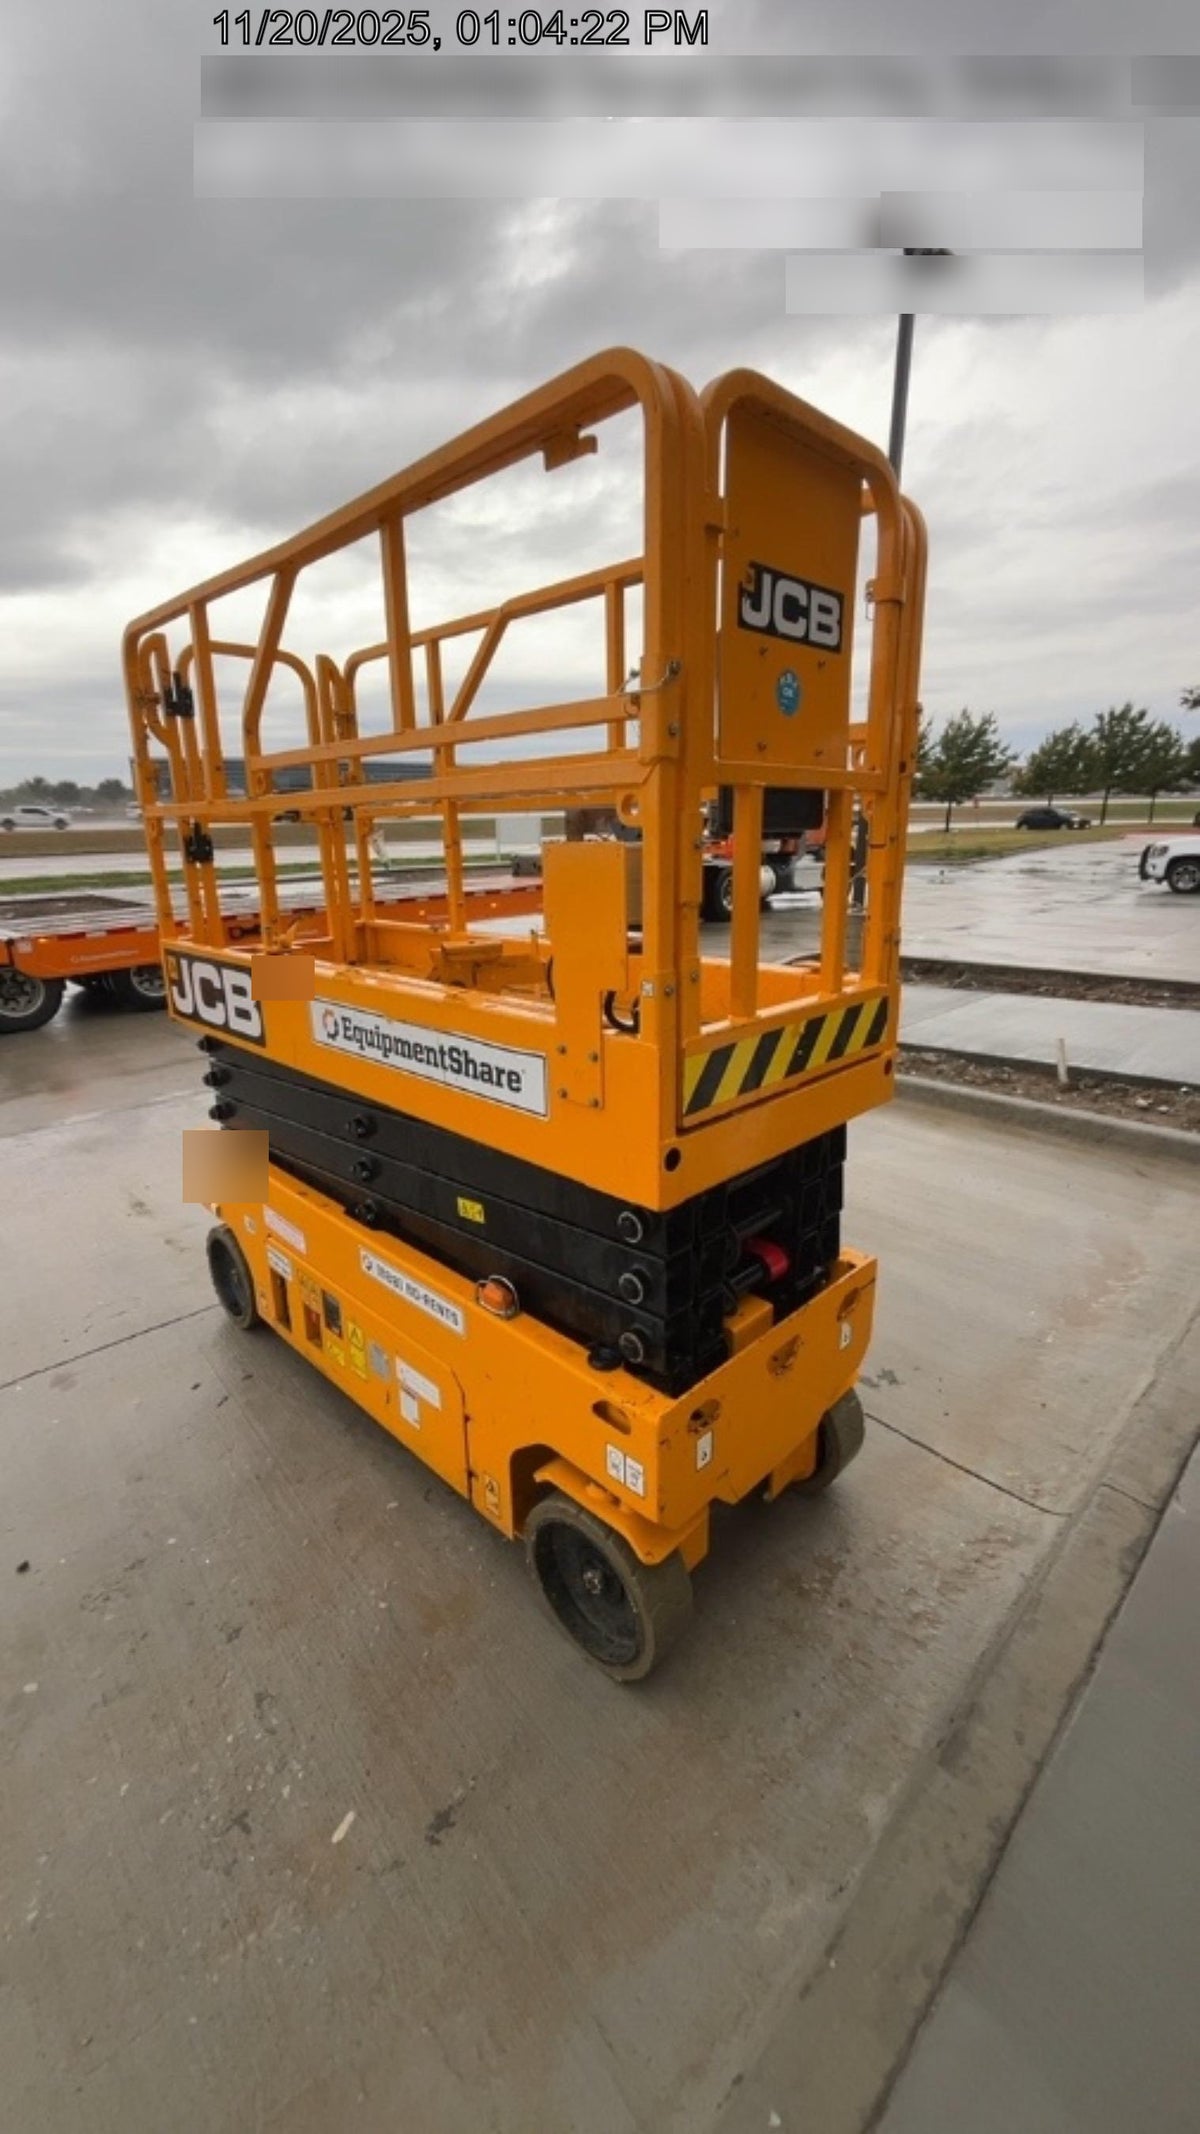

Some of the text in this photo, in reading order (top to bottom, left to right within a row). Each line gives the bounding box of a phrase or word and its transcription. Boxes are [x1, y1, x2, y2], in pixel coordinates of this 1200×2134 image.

[741, 571, 841, 647] JCB
[171, 957, 262, 1037] JCB
[341, 1016, 523, 1093] EquipmentShare
